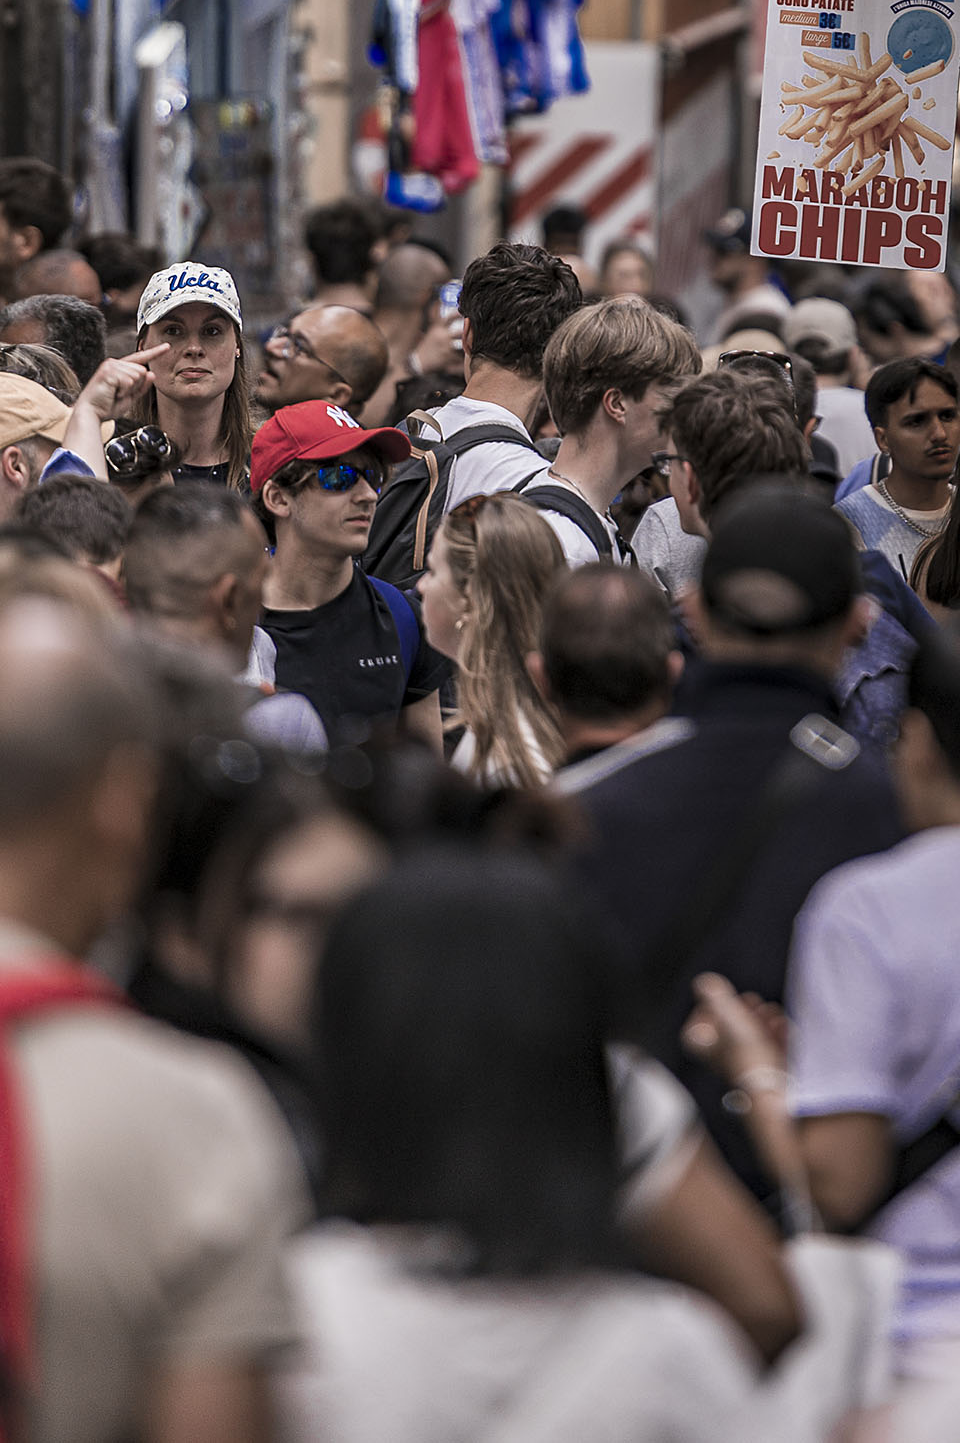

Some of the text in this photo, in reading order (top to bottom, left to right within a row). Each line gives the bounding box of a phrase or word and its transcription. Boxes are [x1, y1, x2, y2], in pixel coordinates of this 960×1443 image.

[781, 12, 817, 26] medium
[761, 165, 947, 215] MARADOH
[758, 201, 944, 270] CHIPS
